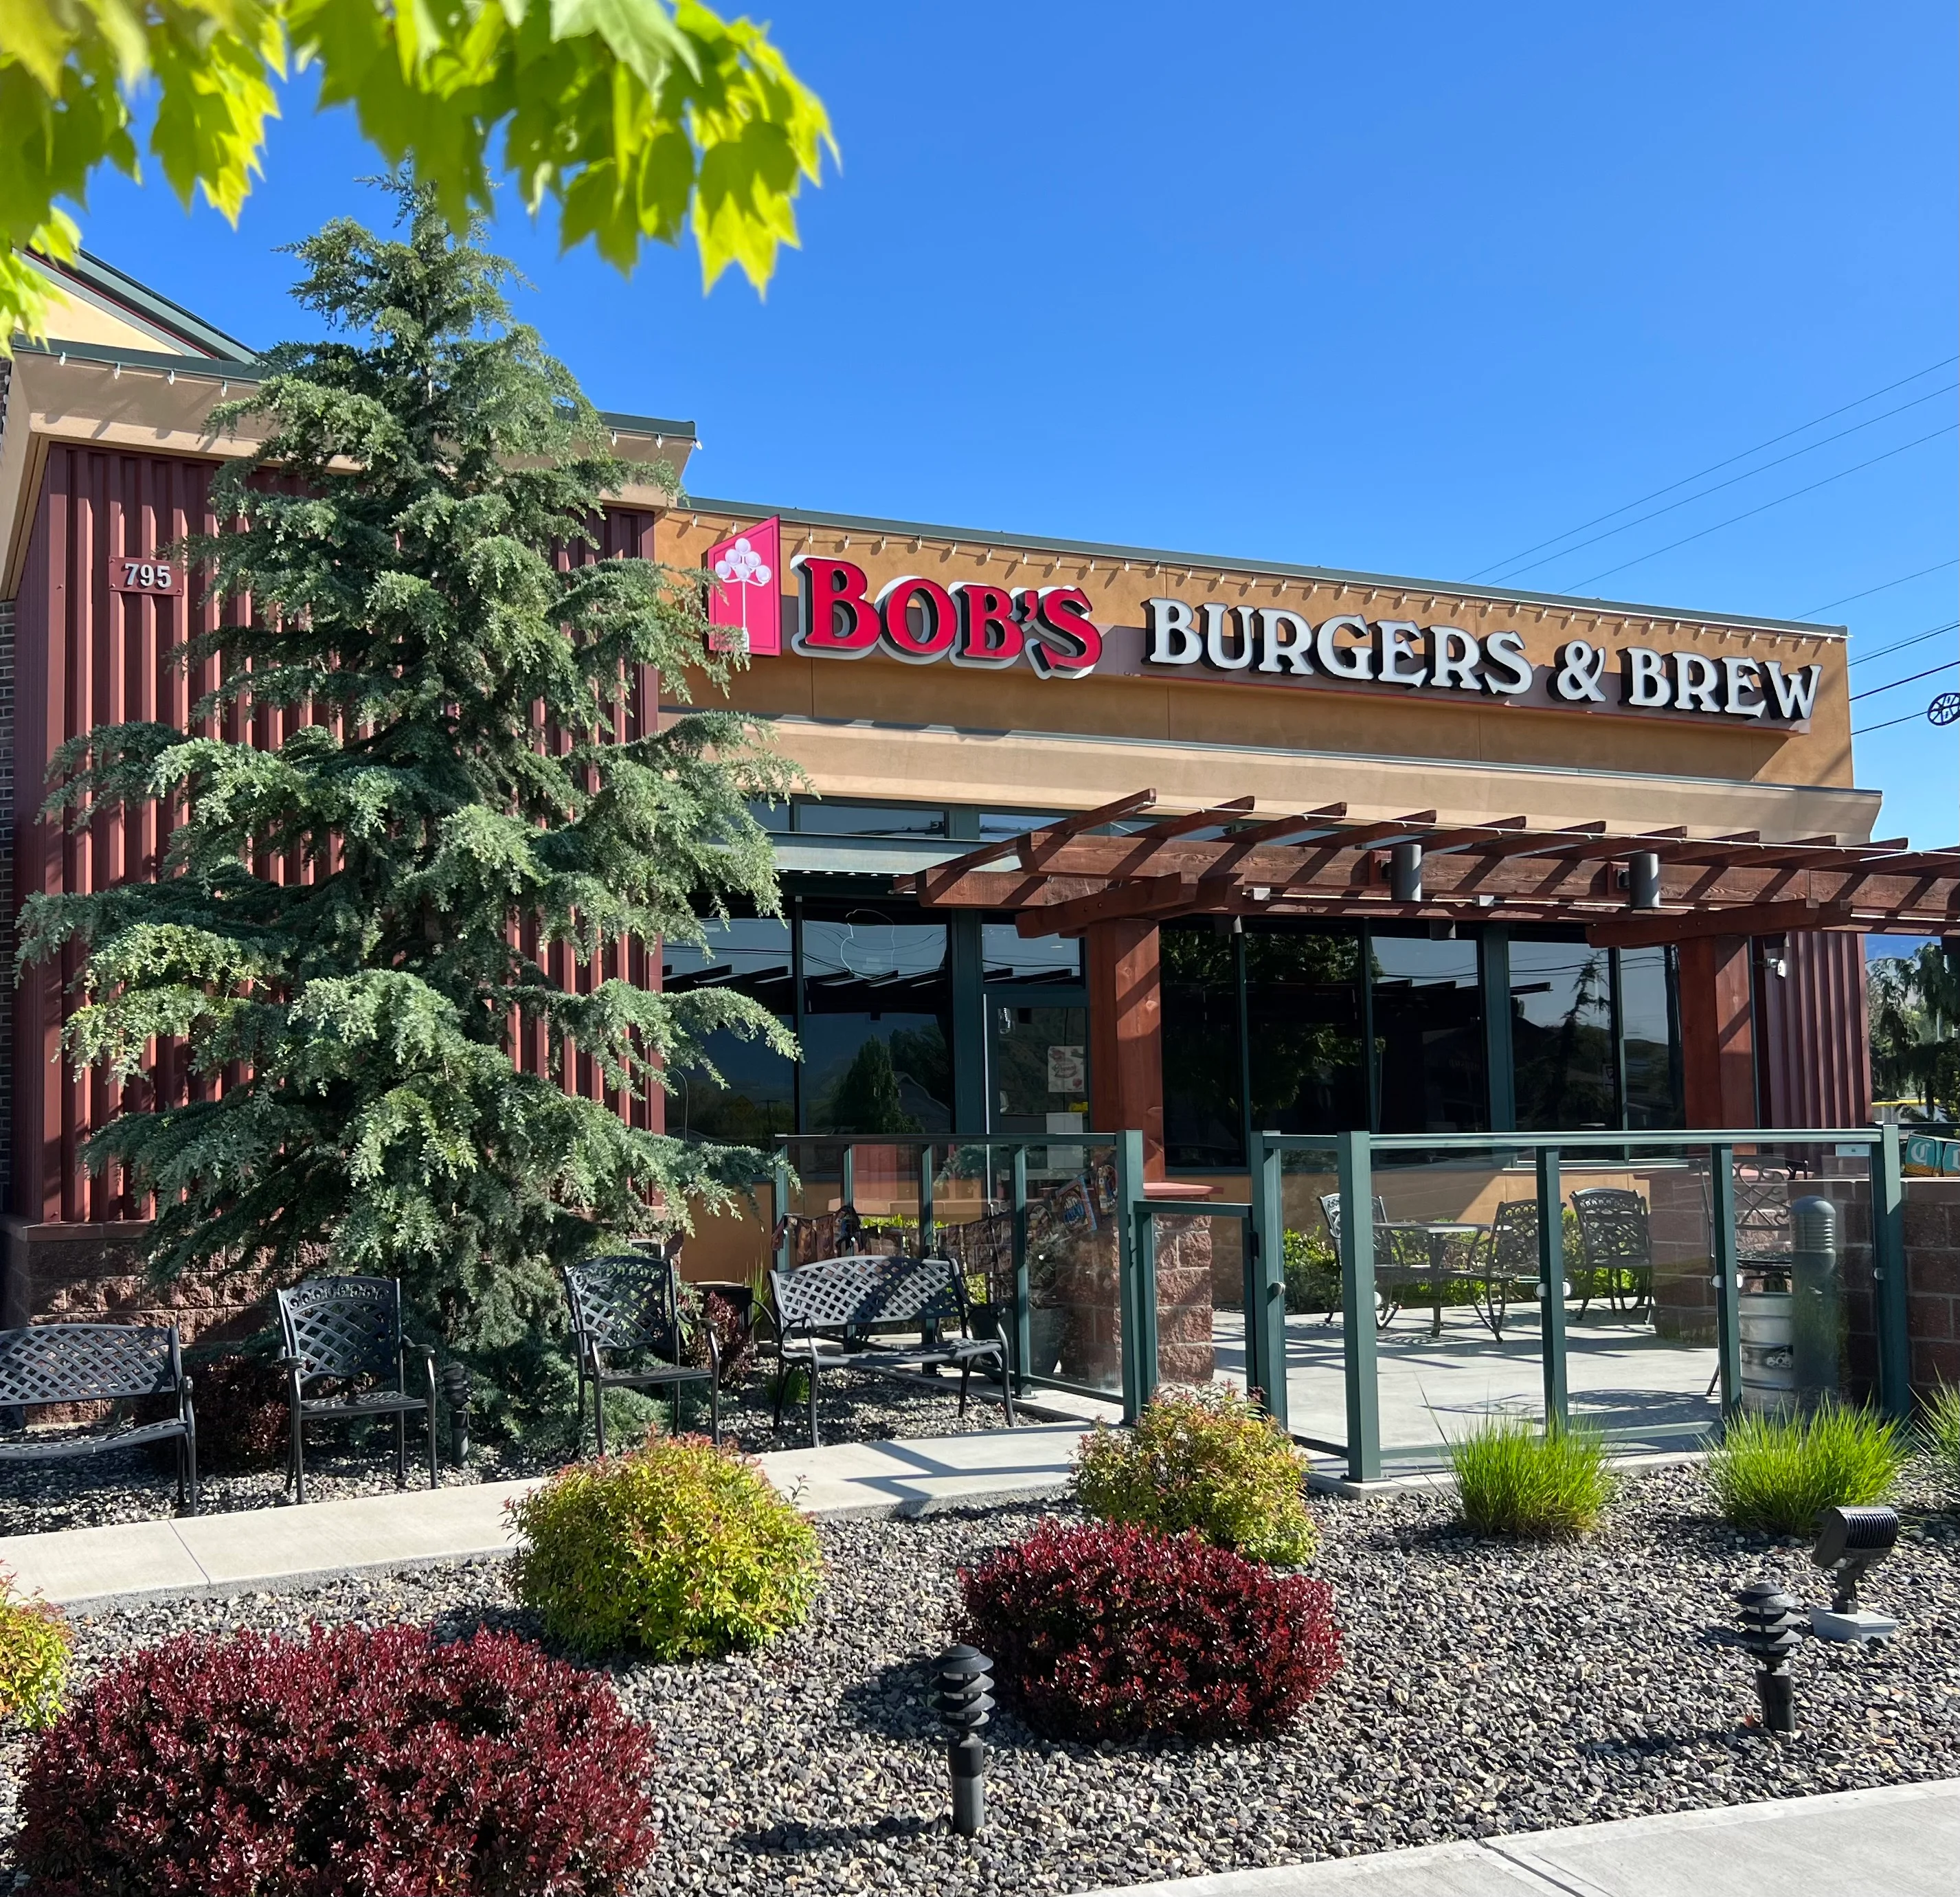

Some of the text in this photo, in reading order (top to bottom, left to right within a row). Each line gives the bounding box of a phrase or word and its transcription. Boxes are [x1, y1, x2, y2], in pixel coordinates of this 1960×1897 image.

[124, 562, 172, 589] 795
[802, 557, 1823, 721] BOB'S BURGERS & BREW
